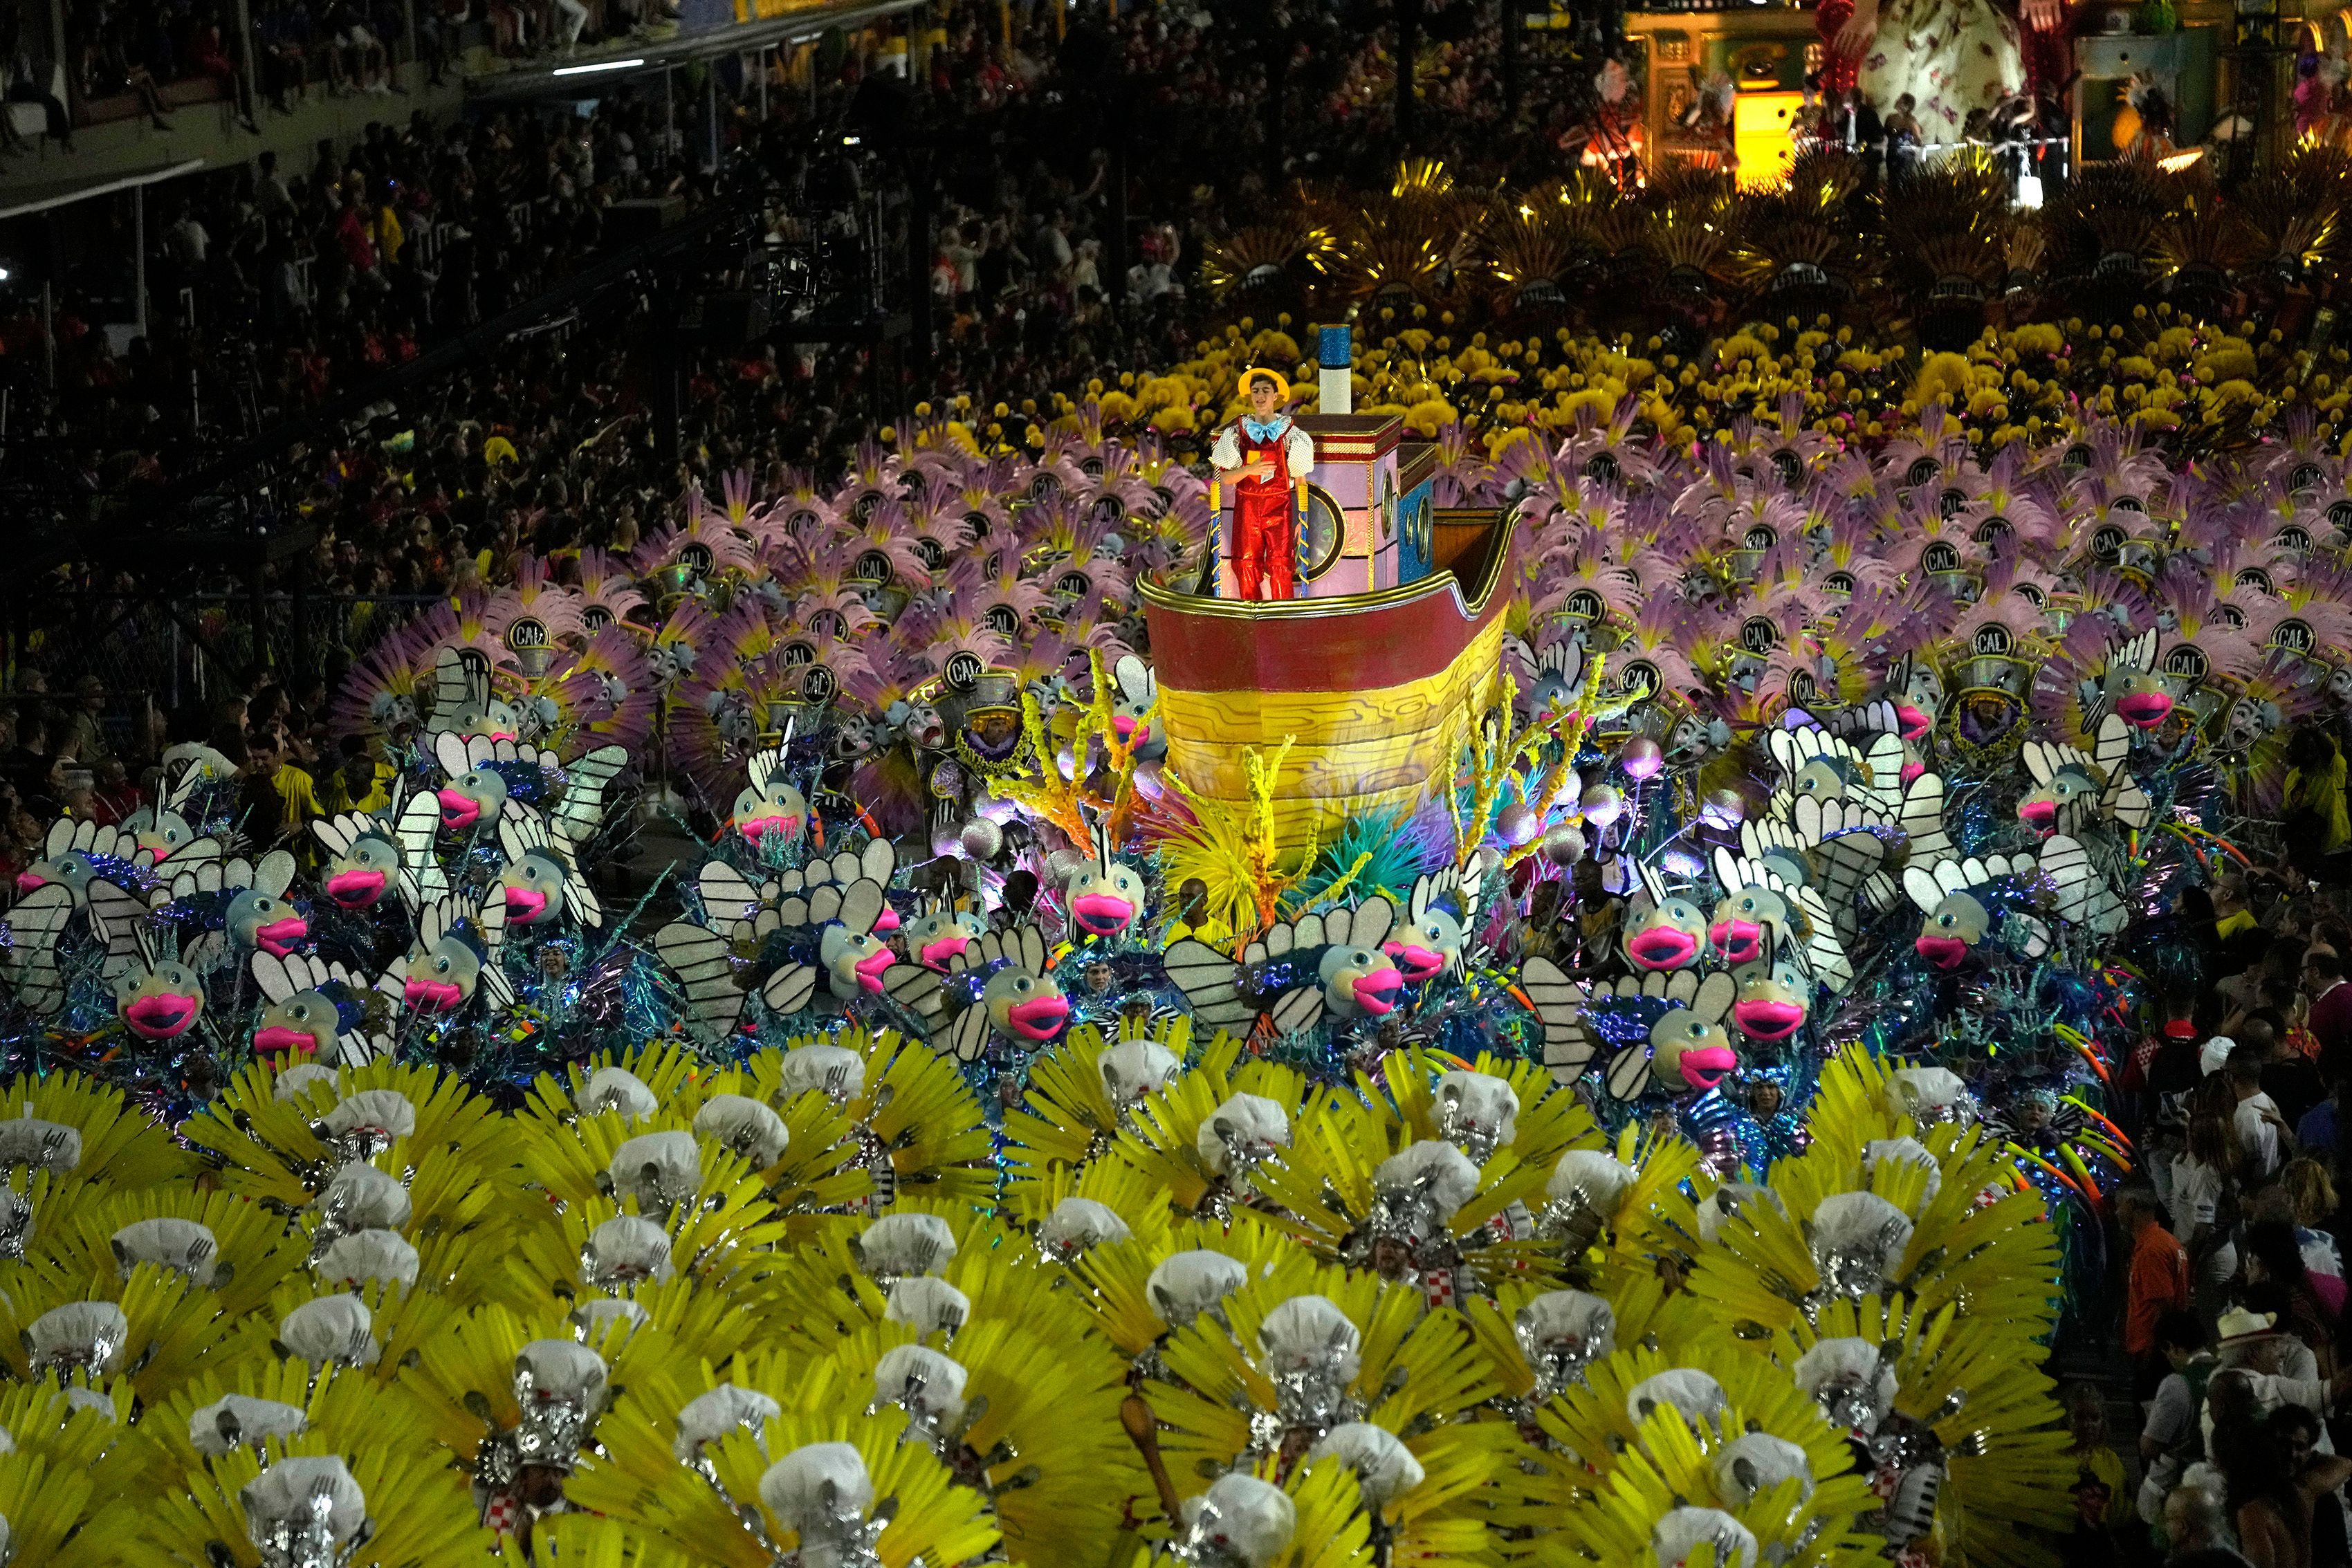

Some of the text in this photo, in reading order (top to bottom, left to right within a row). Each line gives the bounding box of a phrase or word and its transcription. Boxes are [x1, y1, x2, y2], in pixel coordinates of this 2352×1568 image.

[2095, 532, 2119, 554] CAL
[682, 551, 705, 569] CAL
[861, 560, 885, 580] CAL
[1928, 551, 1954, 570] CAL
[1570, 598, 1592, 614] CAL
[517, 626, 542, 645] CAL
[1745, 627, 1770, 647] CAL
[1977, 633, 2005, 653] CAL
[2279, 628, 2305, 649] CAL
[784, 649, 806, 667] CAL
[2172, 655, 2200, 678] CAL
[805, 675, 825, 694] CAL
[1799, 679, 1815, 701] CAL
